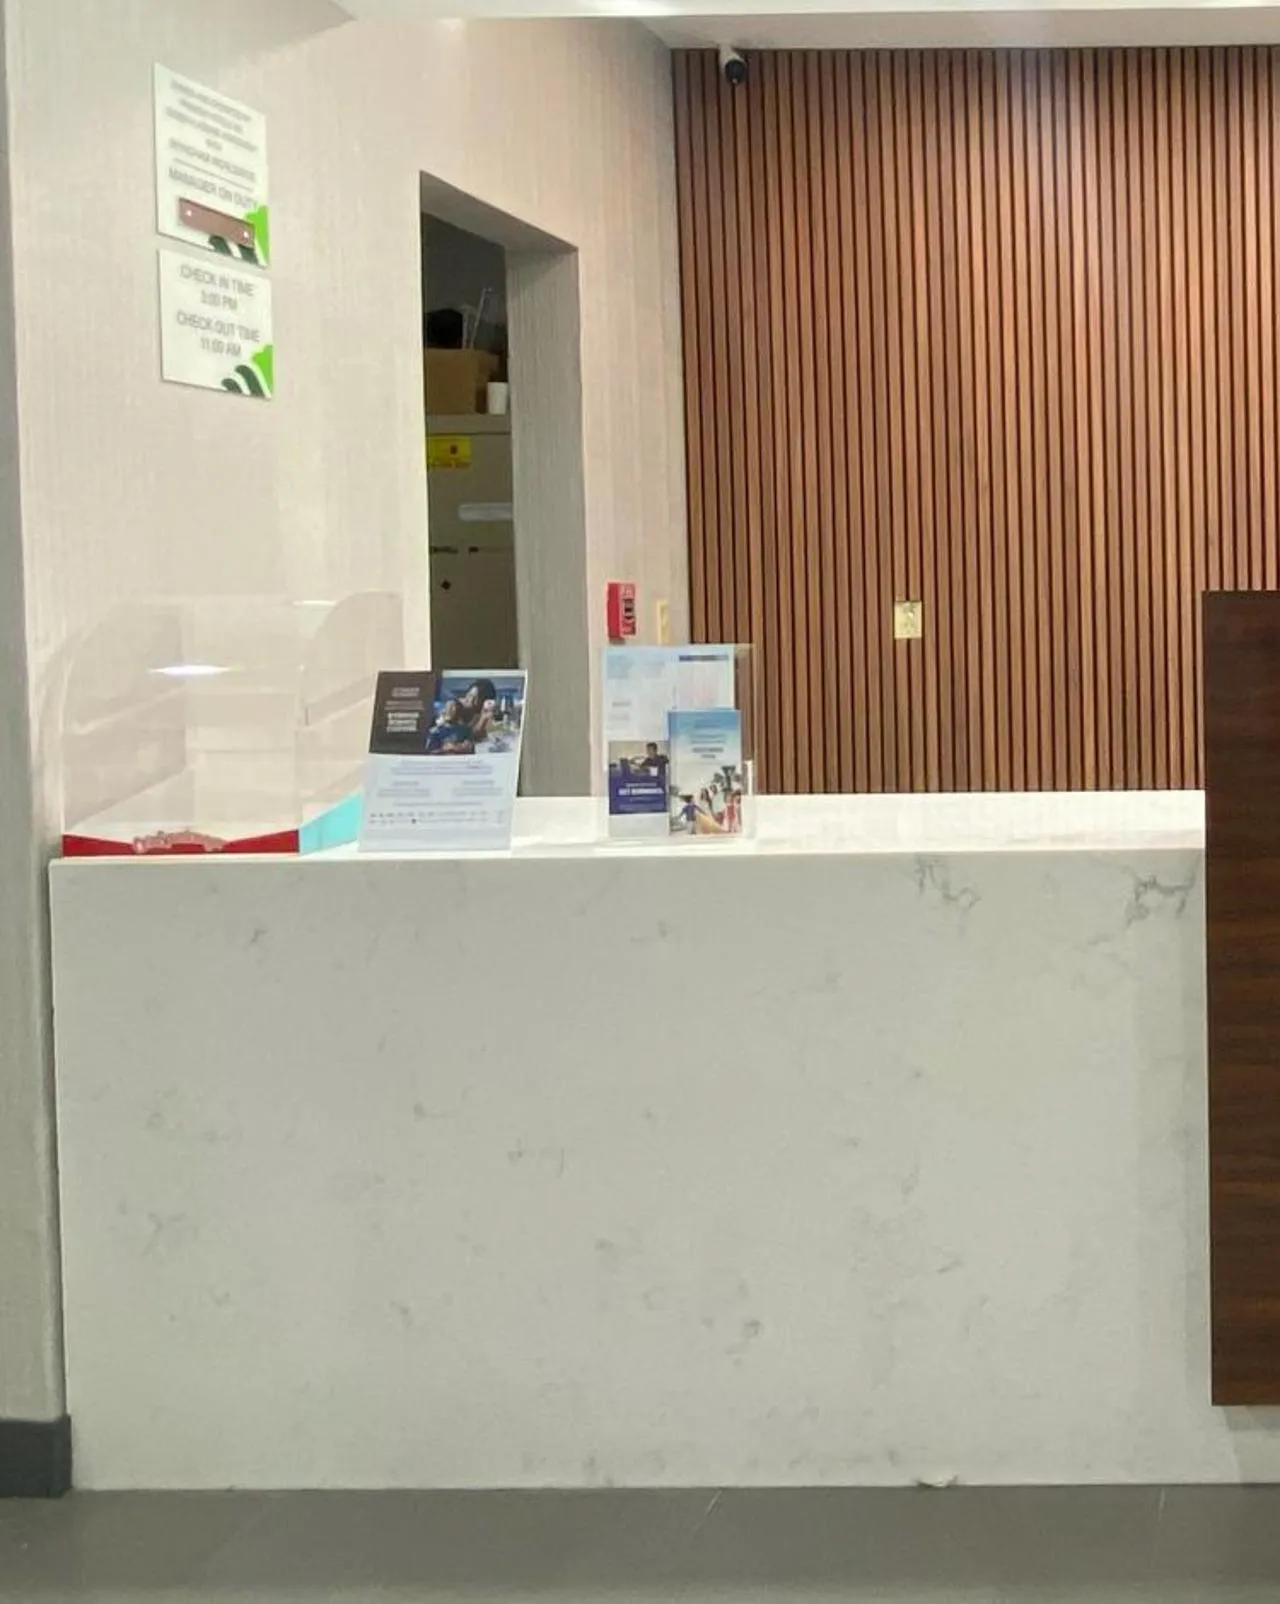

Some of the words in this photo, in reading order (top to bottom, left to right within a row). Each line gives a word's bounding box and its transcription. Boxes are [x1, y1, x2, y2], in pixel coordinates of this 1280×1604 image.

[218, 186, 232, 202] ON
[180, 264, 216, 286] CHECK
[218, 275, 230, 290] IN
[231, 279, 256, 297] TIME
[222, 295, 238, 311] PM
[177, 311, 213, 331] CHECK
[214, 320, 235, 337] OUT
[237, 324, 260, 343] TIME
[226, 342, 242, 357] AM
